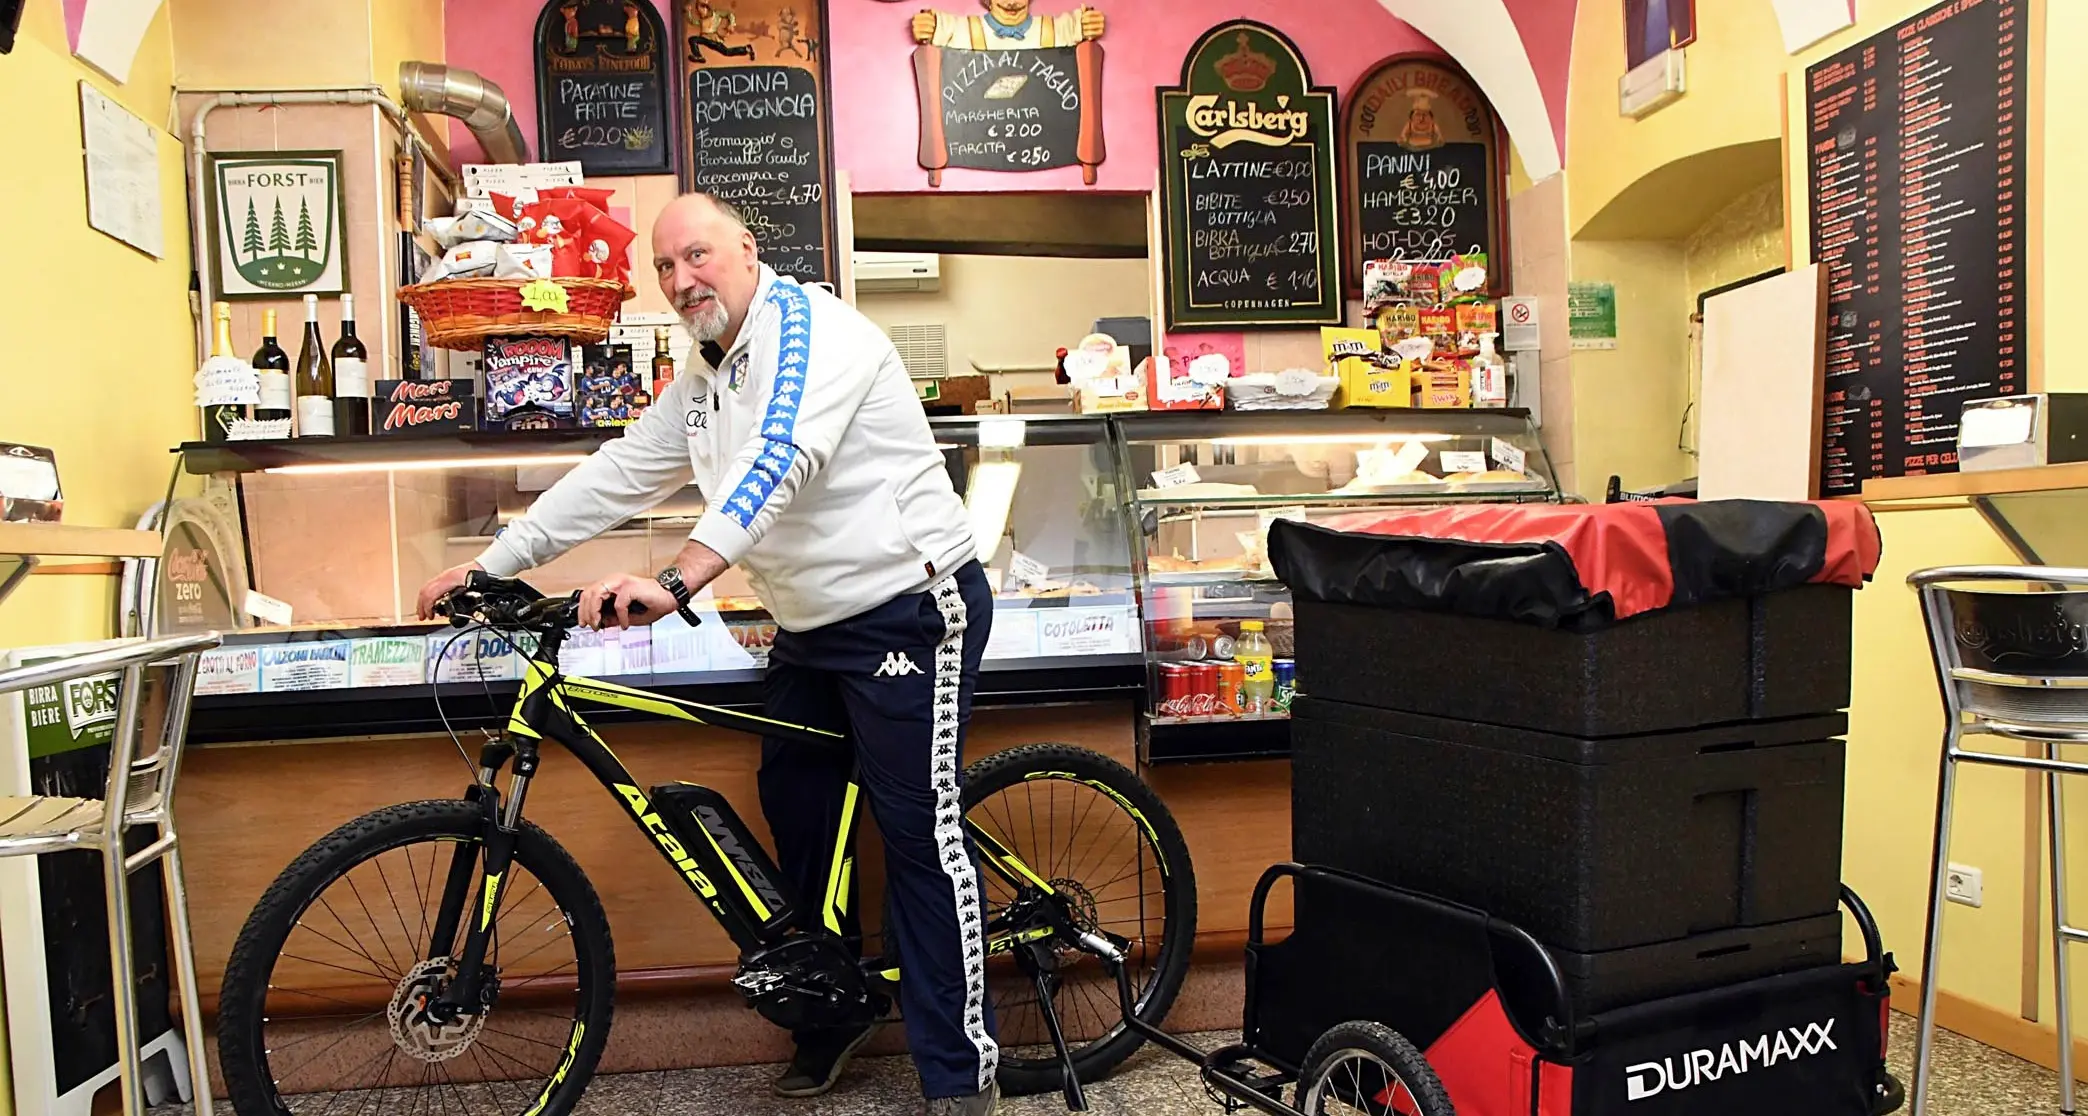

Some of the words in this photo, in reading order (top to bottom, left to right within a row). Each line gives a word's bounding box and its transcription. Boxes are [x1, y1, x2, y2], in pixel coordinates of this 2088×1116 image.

[560, 78, 644, 102] PATATINE
[696, 70, 789, 99] PIADINA
[943, 51, 996, 105] PIZZA
[1029, 56, 1078, 111] TAGLIO
[575, 101, 639, 122] FRITTE
[696, 92, 815, 124] ROMAGNOLA
[945, 106, 1040, 126] MARGHERITA
[1185, 95, 1308, 139] Carlsberg
[695, 127, 777, 154] Formaggio
[949, 141, 1006, 157] FARCITA
[1192, 159, 1273, 179] LATTINE
[1366, 153, 1431, 179] PANINI
[247, 173, 308, 187] FORST
[1195, 192, 1243, 211] BIBITE
[1363, 187, 1478, 209] HAMBURGER
[1208, 209, 1277, 229] BOTTIGLIA
[1195, 228, 1240, 248] BIRRA
[1362, 229, 1457, 252] HOT-DOG
[1208, 242, 1279, 264] BOTTIGLIA
[769, 256, 817, 275] ucola
[1196, 267, 1252, 288] ACQUA
[1224, 298, 1291, 309] COPENHAGEN
[1386, 314, 1416, 323] HARIBO
[1421, 315, 1451, 324] HARIBO
[486, 354, 553, 371] Vampire
[391, 380, 452, 402] Mars
[384, 401, 462, 431] Mars
[175, 583, 202, 601] zero
[1044, 616, 1115, 638] COTOLETTA
[28, 685, 59, 705] BIRRA
[612, 782, 718, 899] Atala
[1625, 1018, 1838, 1101] DURAMAXX
